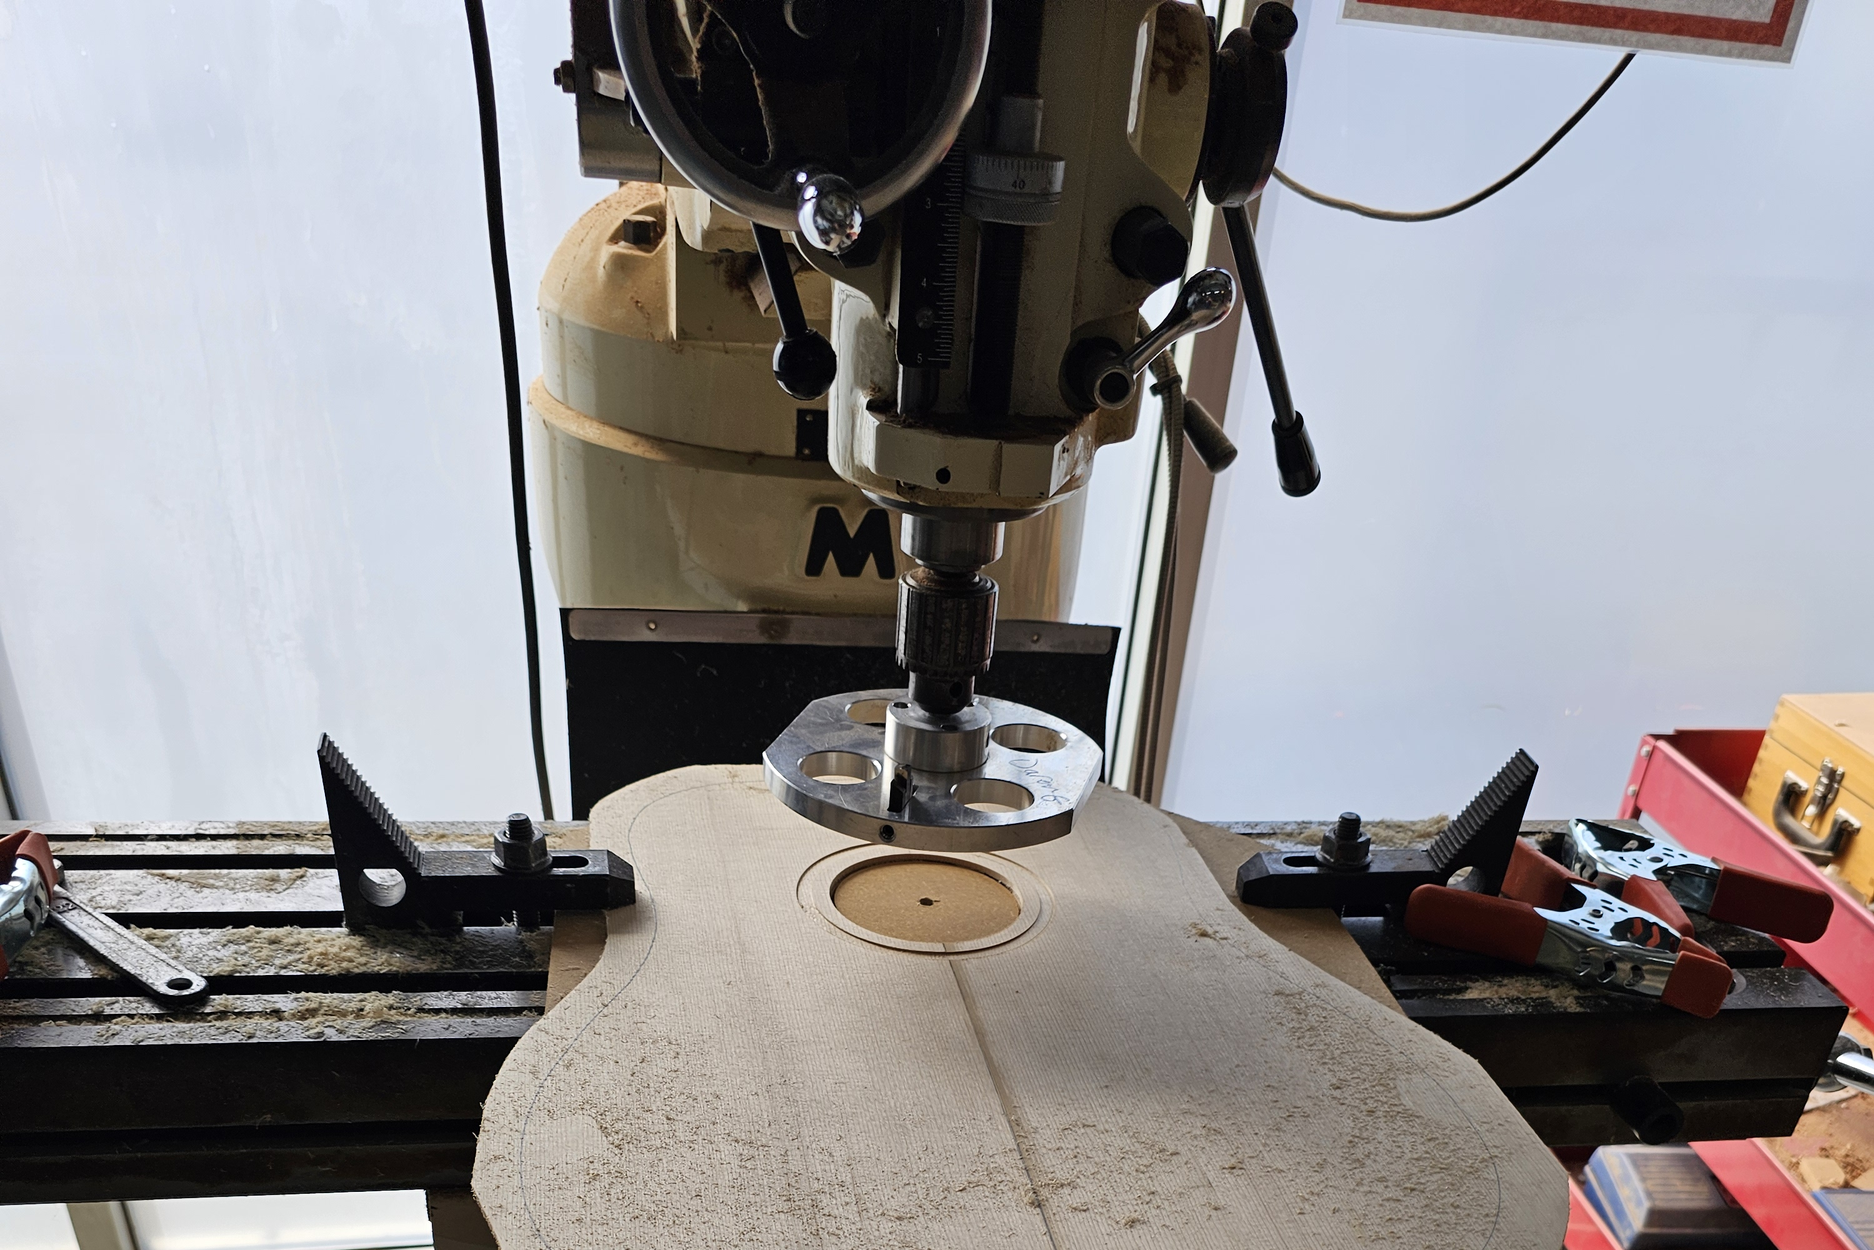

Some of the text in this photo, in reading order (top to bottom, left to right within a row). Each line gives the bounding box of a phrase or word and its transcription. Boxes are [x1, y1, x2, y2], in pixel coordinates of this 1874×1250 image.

[1010, 179, 1027, 191] 40
[925, 198, 932, 209] 3
[921, 277, 927, 288] 4
[916, 353, 923, 364] 5
[804, 506, 896, 580] M
